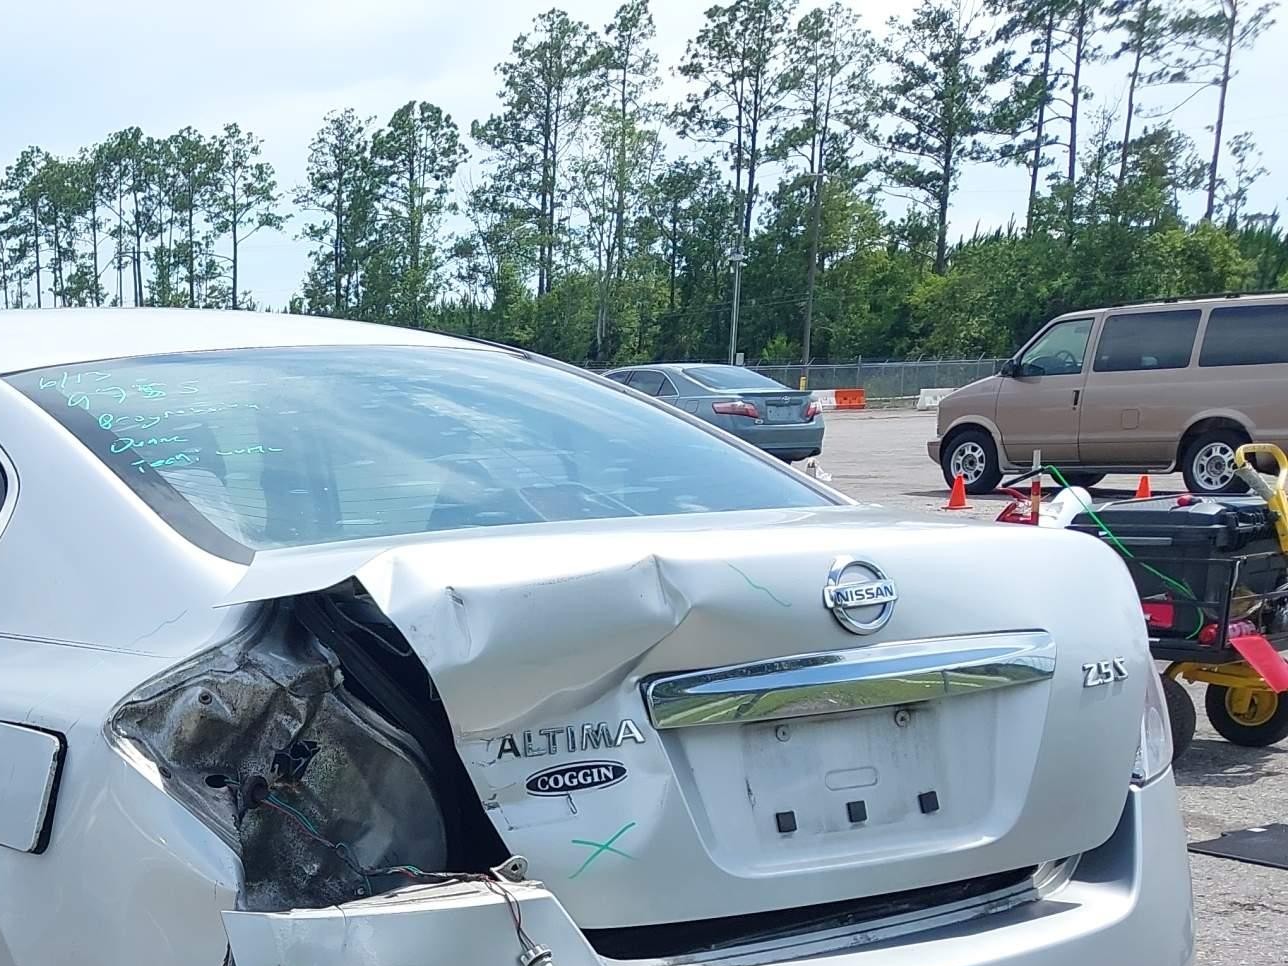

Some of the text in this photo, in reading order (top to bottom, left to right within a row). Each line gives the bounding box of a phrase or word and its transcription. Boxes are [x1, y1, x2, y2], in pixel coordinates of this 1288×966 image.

[835, 584, 894, 603] NISSAN
[497, 718, 646, 761] ALTIMA
[537, 766, 615, 792] COGGIN
